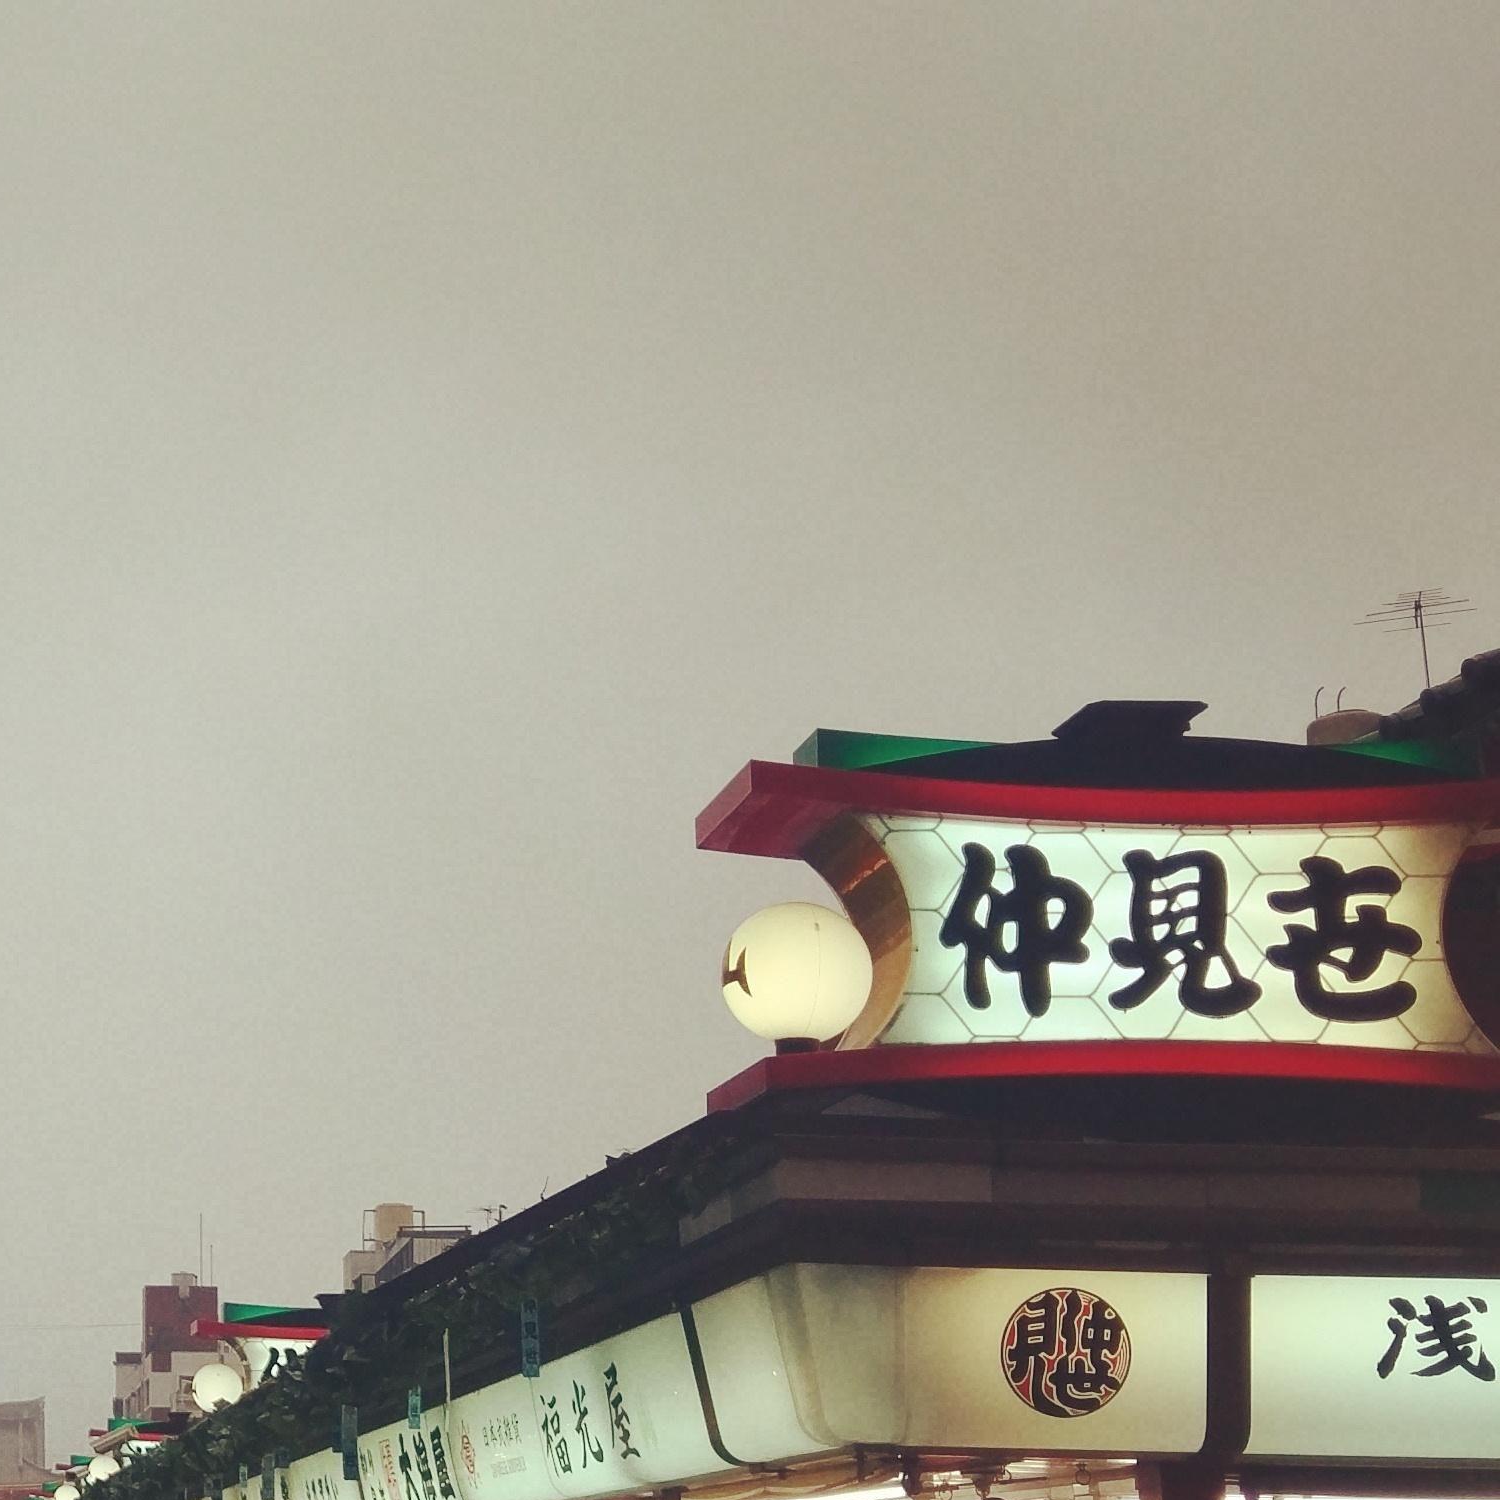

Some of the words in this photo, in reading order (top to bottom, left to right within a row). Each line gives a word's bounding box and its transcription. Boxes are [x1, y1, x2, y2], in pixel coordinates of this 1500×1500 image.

[939, 842, 1423, 1023] 仲見世
[1376, 1294, 1496, 1382] 浅
[539, 1361, 641, 1478] 福光屋
